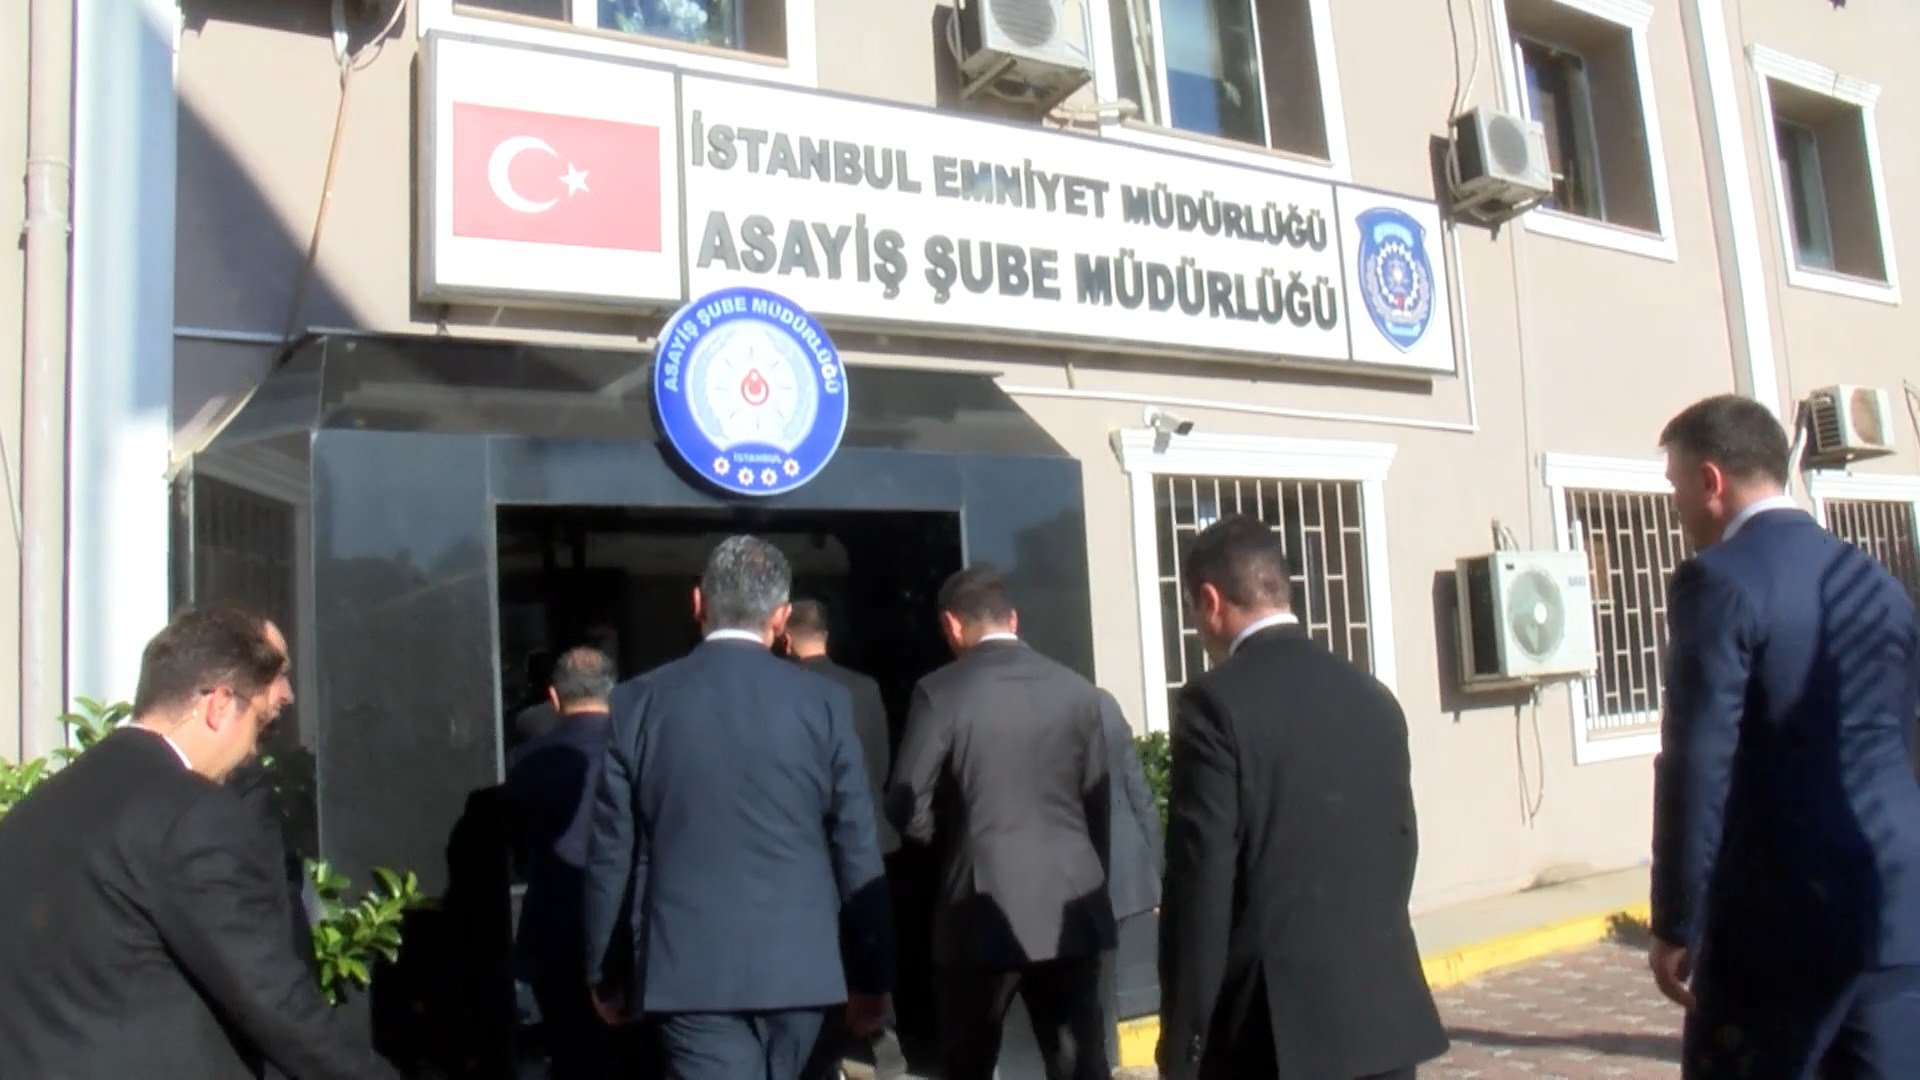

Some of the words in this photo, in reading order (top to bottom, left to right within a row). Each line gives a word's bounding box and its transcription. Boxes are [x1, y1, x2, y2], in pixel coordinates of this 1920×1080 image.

[690, 110, 922, 194] İSTANBUL
[932, 157, 1109, 218] EMNİYET
[1121, 183, 1328, 251] MÜDÜRLÜĞÜ
[697, 211, 908, 299] ASAYİŞ
[923, 235, 1061, 304] ŞUBE
[1074, 249, 1338, 331] MÜDÜRLÜĞÜ
[665, 319, 699, 392] ASAYİŞ
[696, 297, 748, 327] ŞUBE
